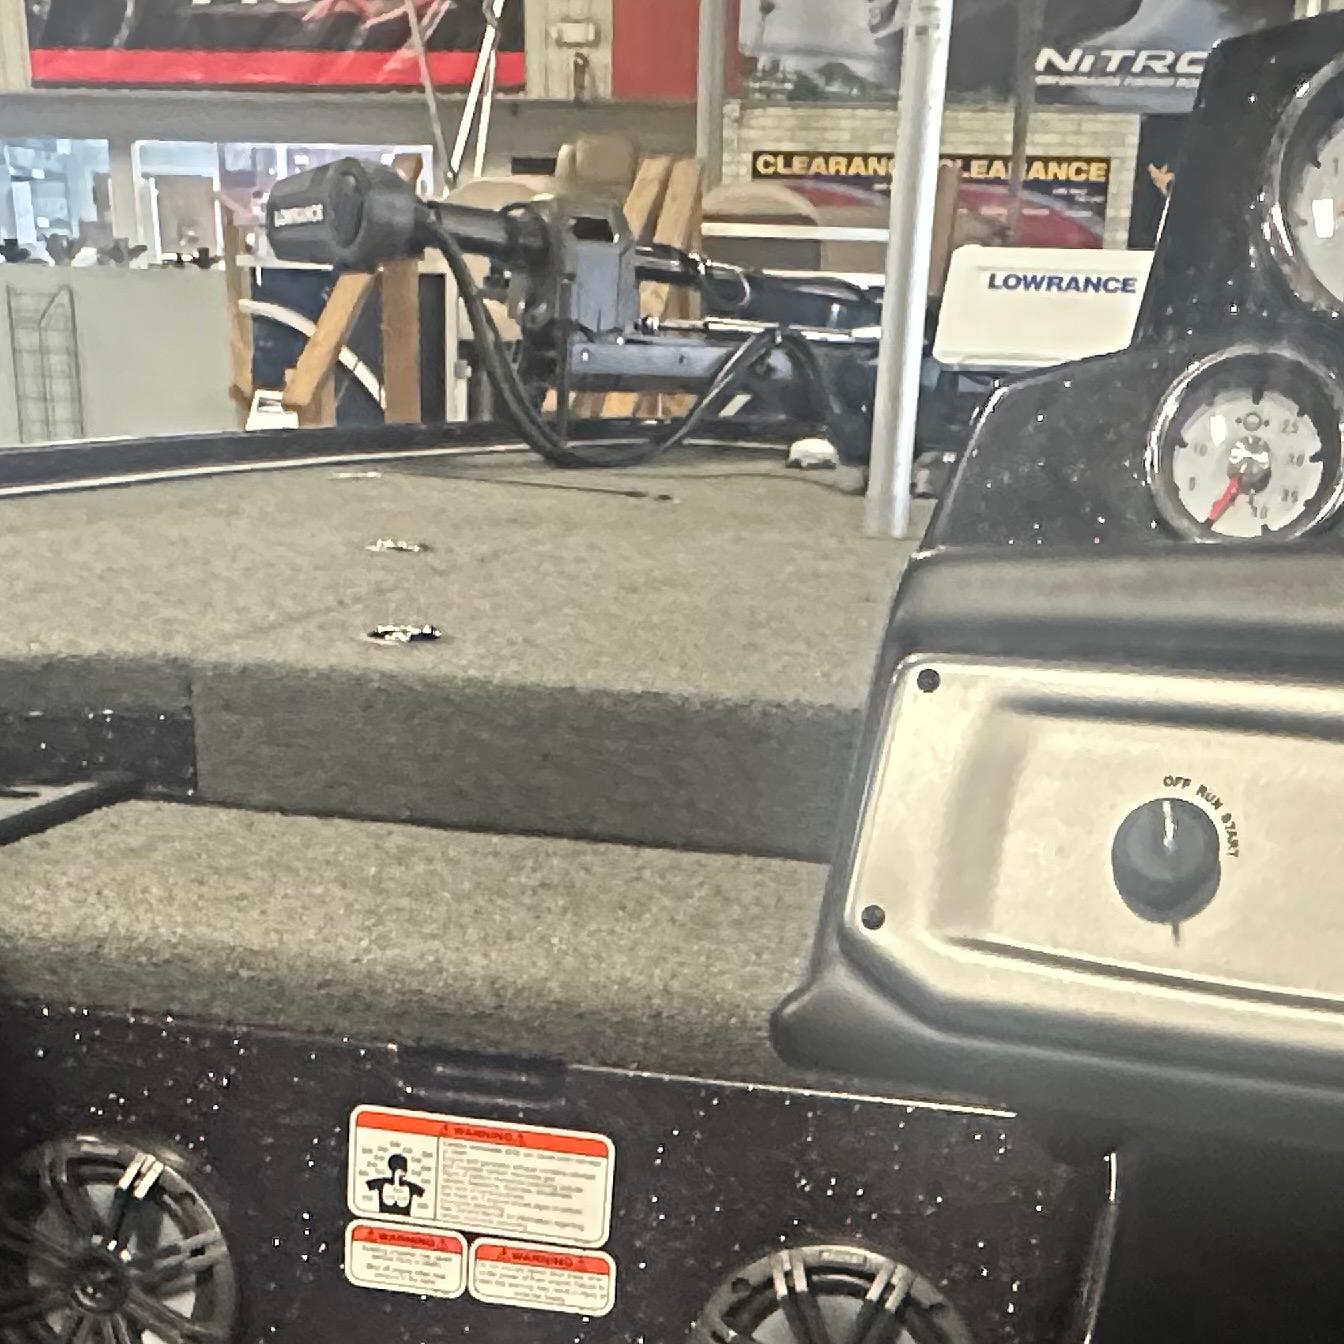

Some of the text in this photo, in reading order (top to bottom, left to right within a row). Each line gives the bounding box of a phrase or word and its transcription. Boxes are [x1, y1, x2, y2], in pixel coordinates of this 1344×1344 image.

[756, 154, 896, 176] CLEARAN
[987, 273, 1138, 294] LOWRANCE
[1163, 775, 1240, 858] OFF RUN START
[453, 1126, 514, 1142] WARNING
[378, 1232, 436, 1248] WARNING
[511, 1250, 574, 1267] WARNING
